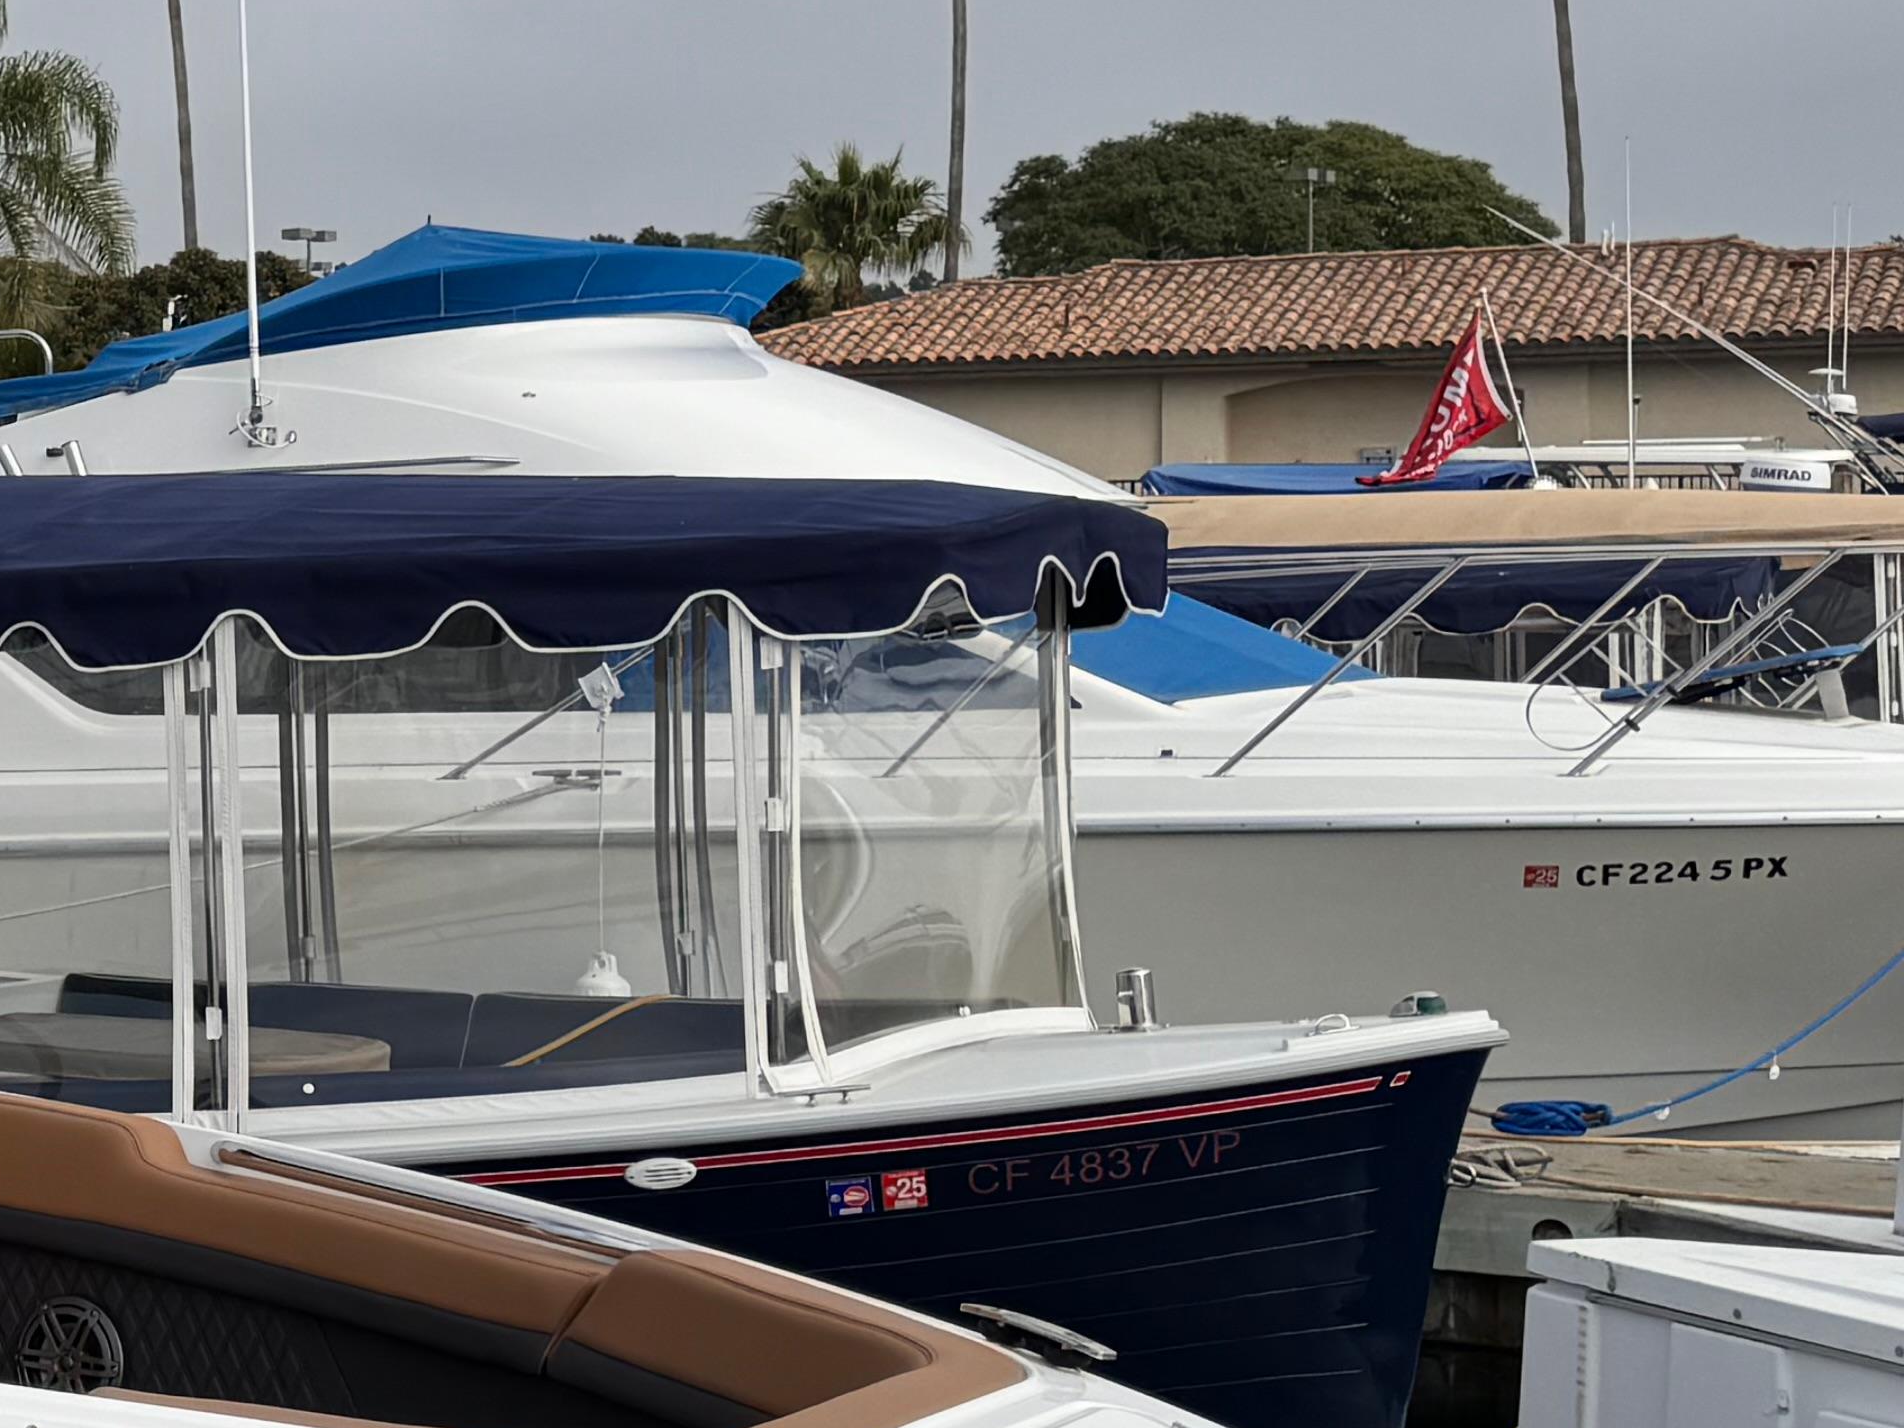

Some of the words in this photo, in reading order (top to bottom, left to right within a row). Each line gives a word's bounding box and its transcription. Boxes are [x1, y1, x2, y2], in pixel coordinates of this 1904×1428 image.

[1750, 467, 1812, 482] SIMRAD
[1535, 869, 1558, 883] 25
[968, 1159, 1031, 1195] CF
[1049, 1142, 1160, 1187] 4837
[1178, 1129, 1242, 1170] VP
[896, 1175, 927, 1199] 25
